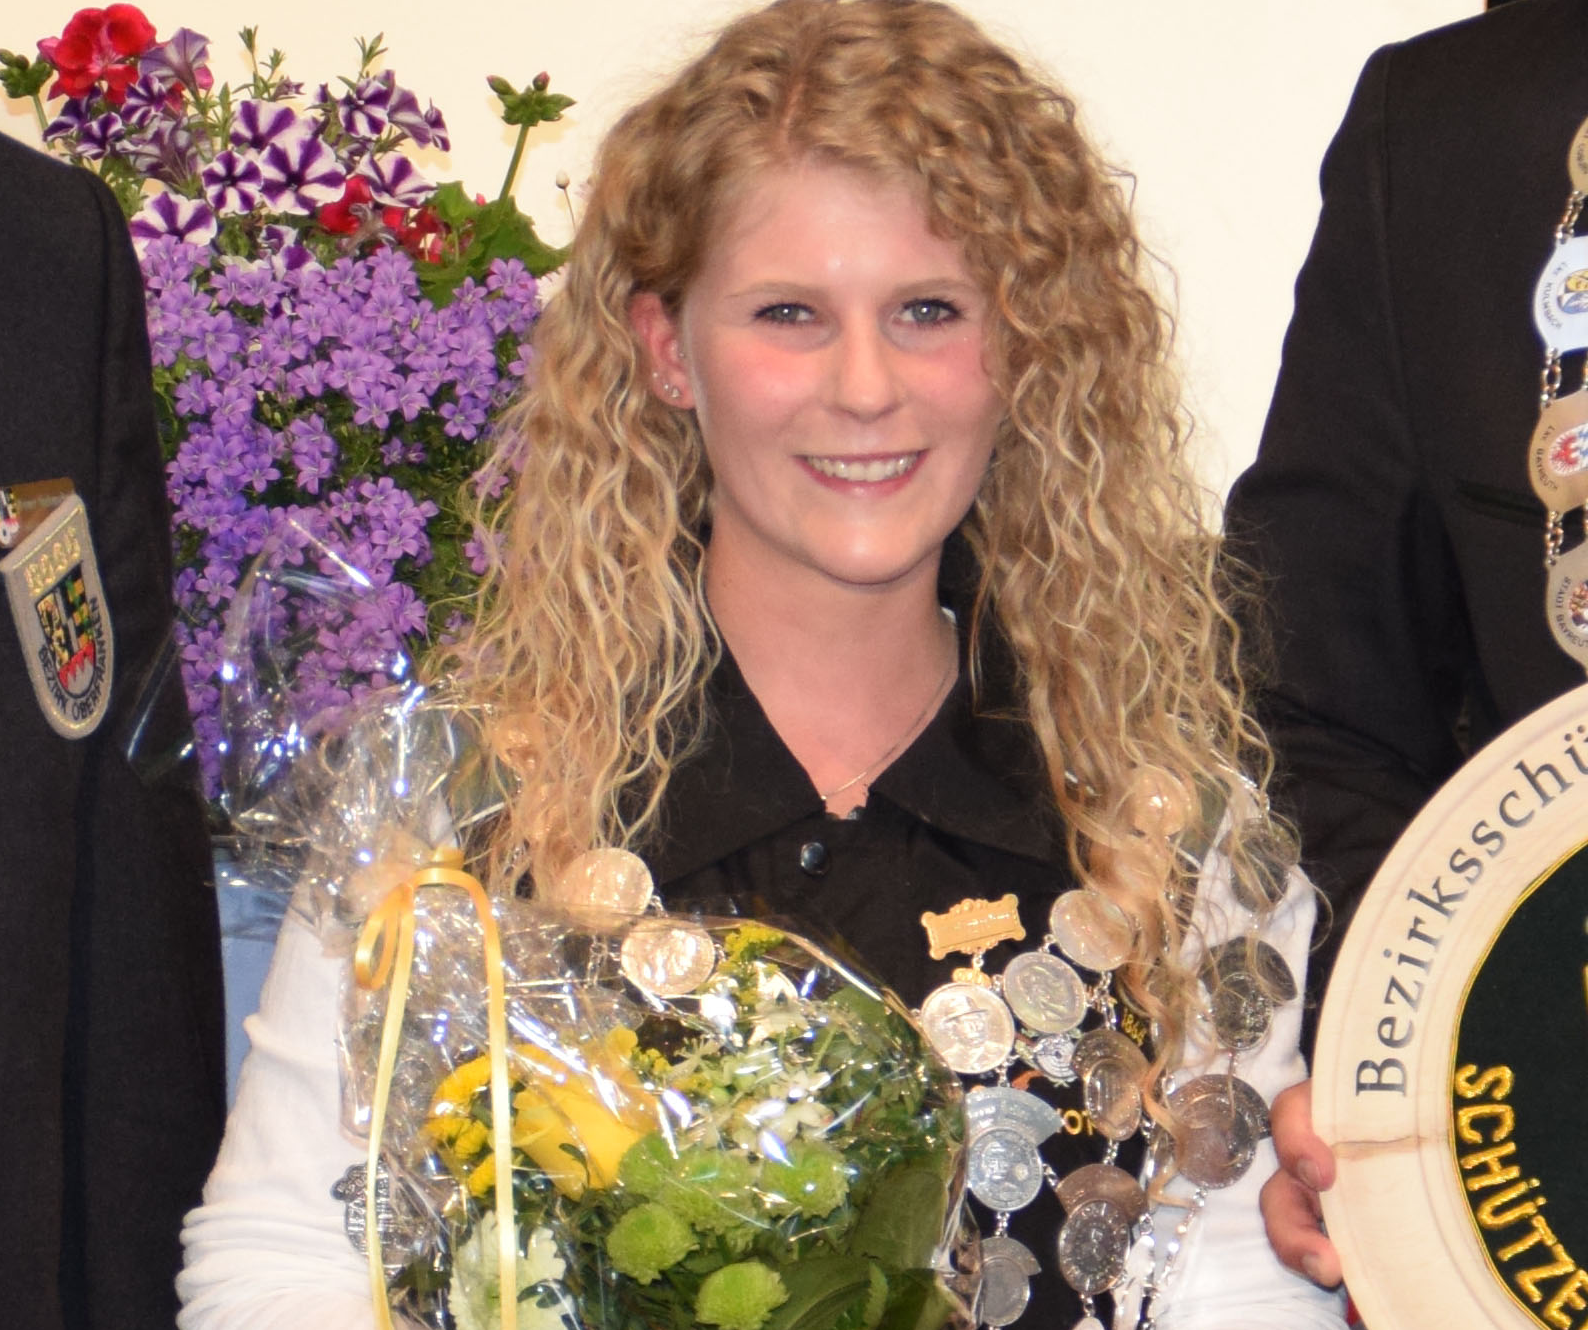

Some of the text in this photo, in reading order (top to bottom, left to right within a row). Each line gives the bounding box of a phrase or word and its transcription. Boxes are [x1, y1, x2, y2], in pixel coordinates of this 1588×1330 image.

[1556, 576, 1572, 609] STADT
[38, 597, 107, 721] BEZIRK OBERFRANKEN
